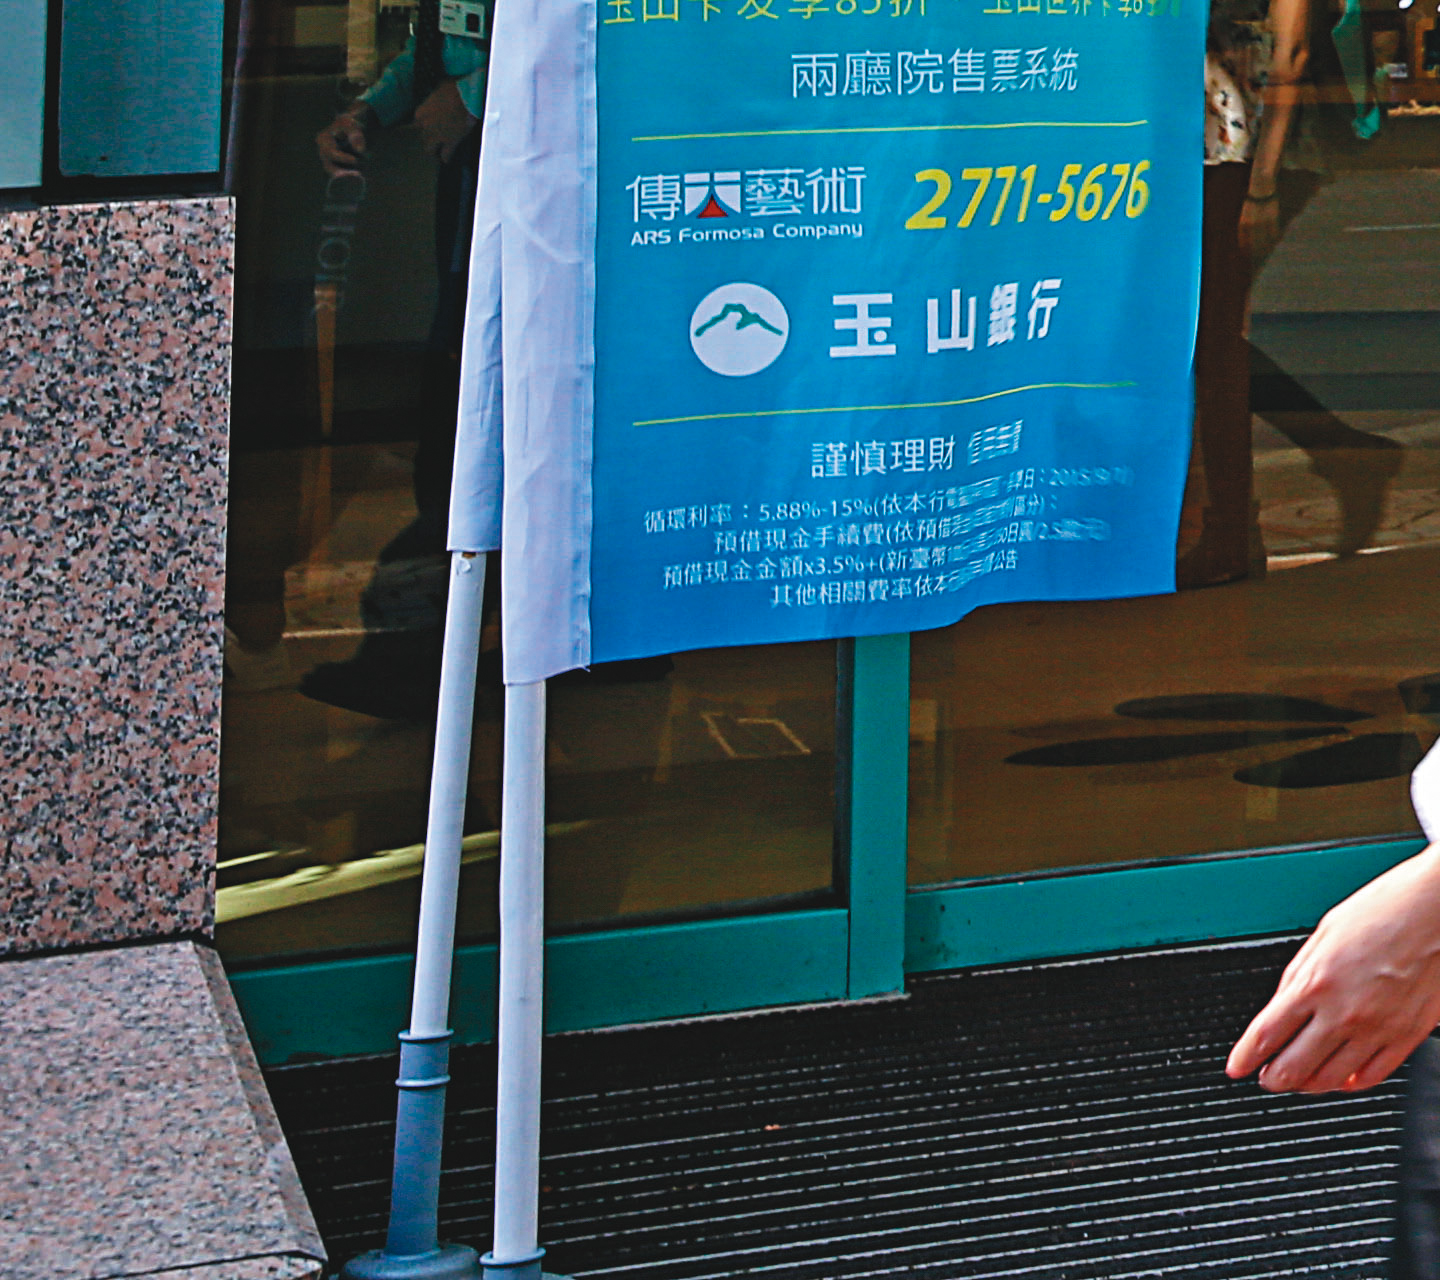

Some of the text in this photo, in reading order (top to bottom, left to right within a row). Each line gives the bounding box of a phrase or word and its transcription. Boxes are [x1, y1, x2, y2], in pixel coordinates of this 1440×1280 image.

[792, 46, 1080, 99] 兩廳院售票系統
[905, 159, 1151, 230] 2771-5676
[631, 221, 863, 245] ARS Formosa Company
[829, 278, 1062, 359] 玉山銀行
